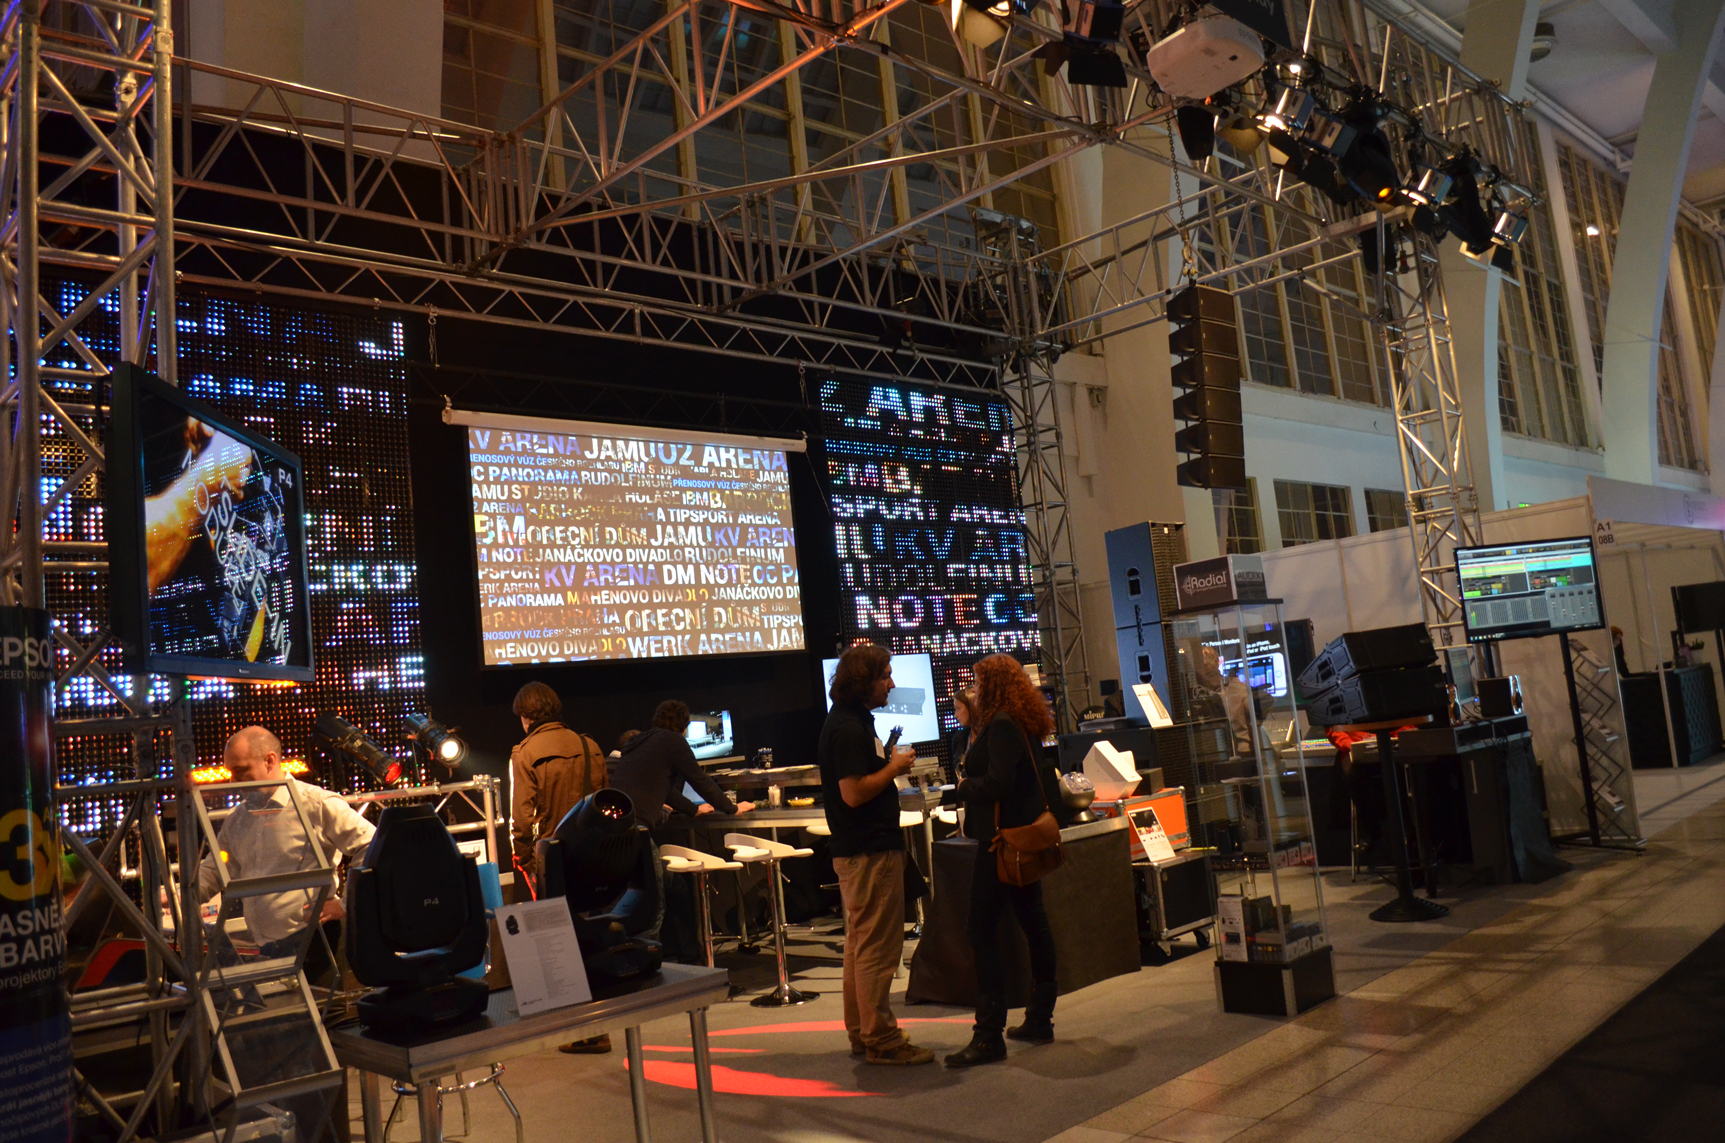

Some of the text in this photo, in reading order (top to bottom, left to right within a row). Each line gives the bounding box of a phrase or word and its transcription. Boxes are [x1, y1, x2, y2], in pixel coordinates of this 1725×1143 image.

[499, 431, 581, 455] ARENA
[584, 438, 656, 462] JAMU
[702, 444, 788, 471] ARENA
[488, 465, 581, 485] PANORAMA
[517, 454, 535, 465] VŮZ
[621, 460, 645, 473] IBM
[278, 467, 293, 489] P4
[482, 502, 524, 513] ARENA
[667, 508, 733, 524] TIPSPORT
[737, 511, 781, 525] ARENA
[527, 522, 600, 545] OBECNÍ
[605, 522, 647, 545] DŮM
[650, 524, 712, 547] JAMU
[714, 526, 740, 547] KV
[1597, 521, 1611, 533] A1
[535, 545, 623, 563] JANÁČKOVO
[626, 548, 683, 562] DIVADLO
[544, 564, 577, 587] KV
[583, 563, 660, 587] ARENA
[662, 564, 696, 585] DM
[700, 564, 751, 585] NOTE
[753, 564, 778, 584] OC
[1191, 571, 1226, 589] Radial
[488, 593, 565, 608] PANORAMA
[567, 589, 649, 605] MAHENOVO
[652, 588, 709, 603] DIVADLO
[711, 583, 784, 600] JANÁČKOVO
[503, 582, 540, 594] ARENA
[624, 602, 707, 632] OBECNÍ
[713, 601, 760, 629] DŮM
[854, 594, 980, 629] NOTE
[524, 627, 541, 639] VŮZ
[563, 637, 627, 655] DIVADLO
[627, 634, 693, 659] WERK
[698, 630, 766, 655] ARENA
[0, 636, 51, 668] PSO
